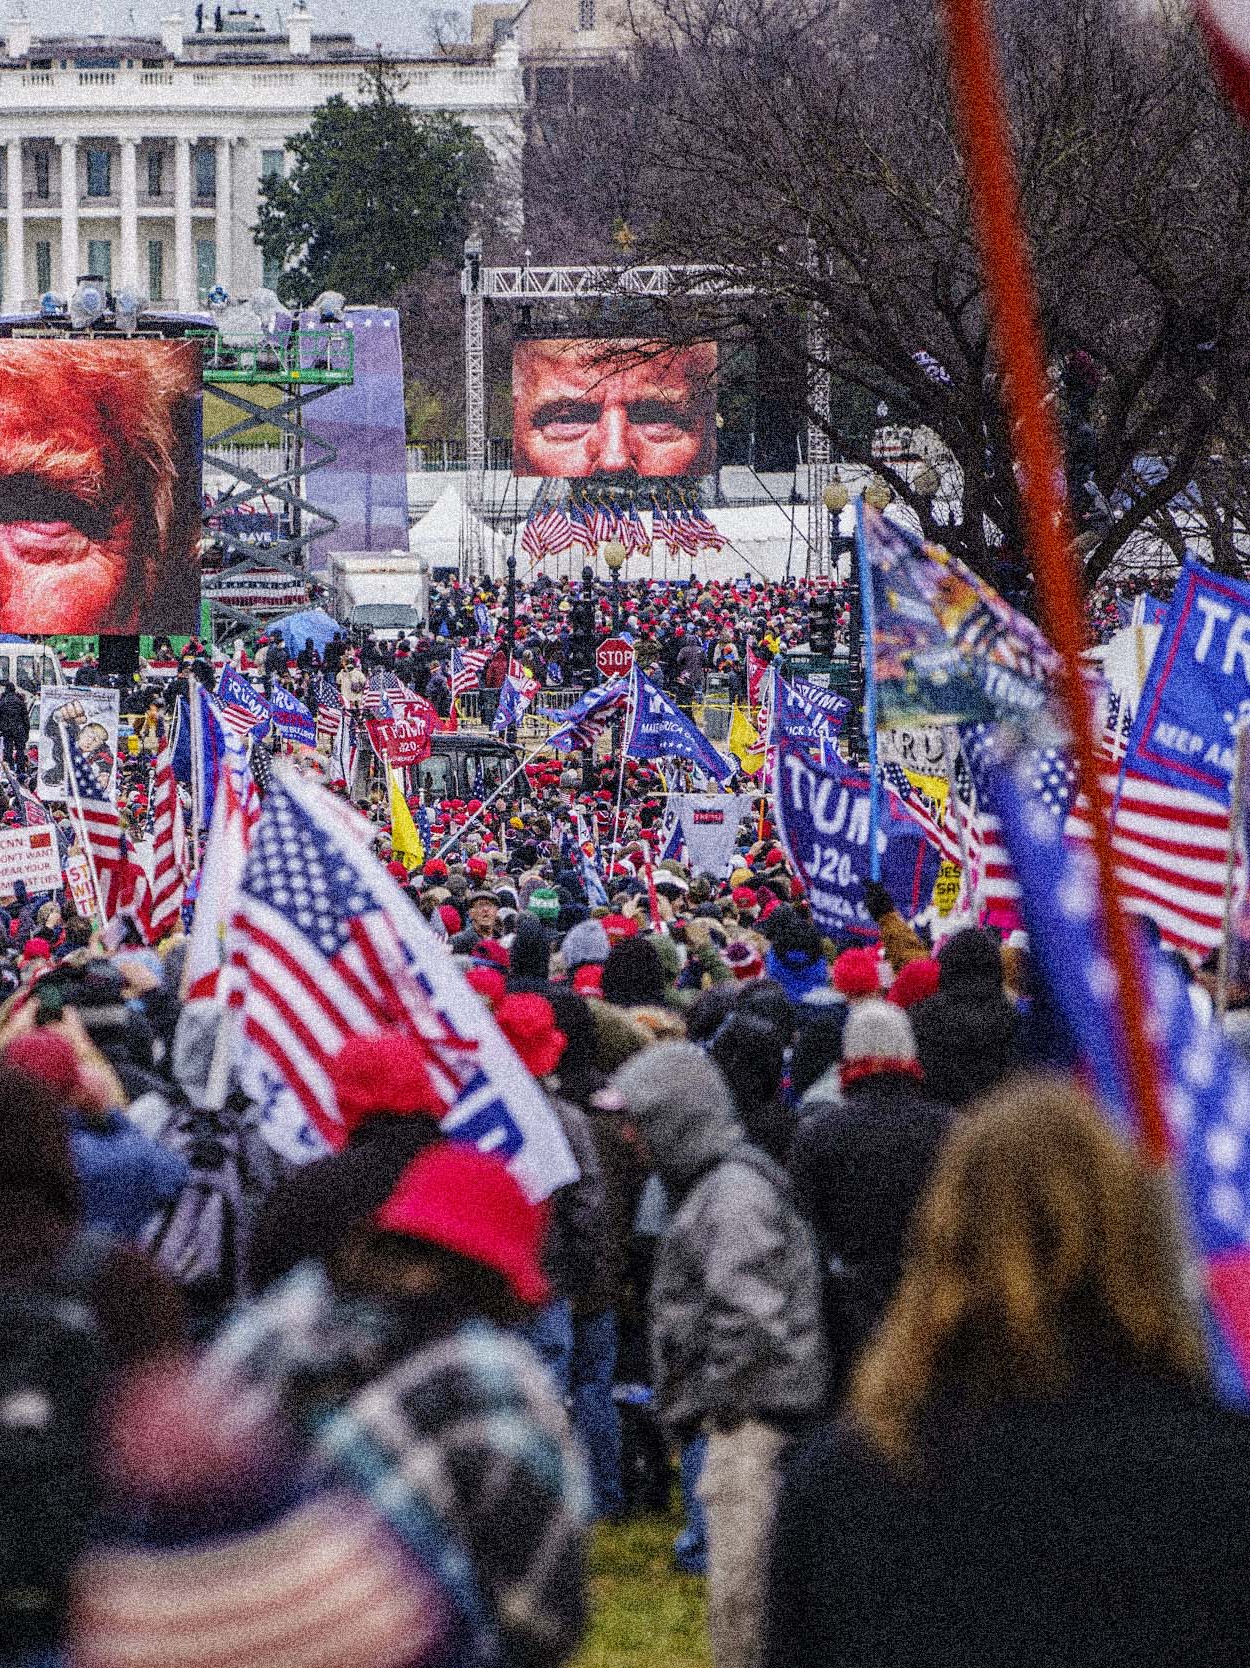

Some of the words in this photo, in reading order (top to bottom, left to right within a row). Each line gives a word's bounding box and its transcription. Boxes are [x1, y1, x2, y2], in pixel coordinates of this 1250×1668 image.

[598, 650, 632, 666] STOP
[26, 848, 54, 859] WANT
[24, 862, 51, 874] YOUR
